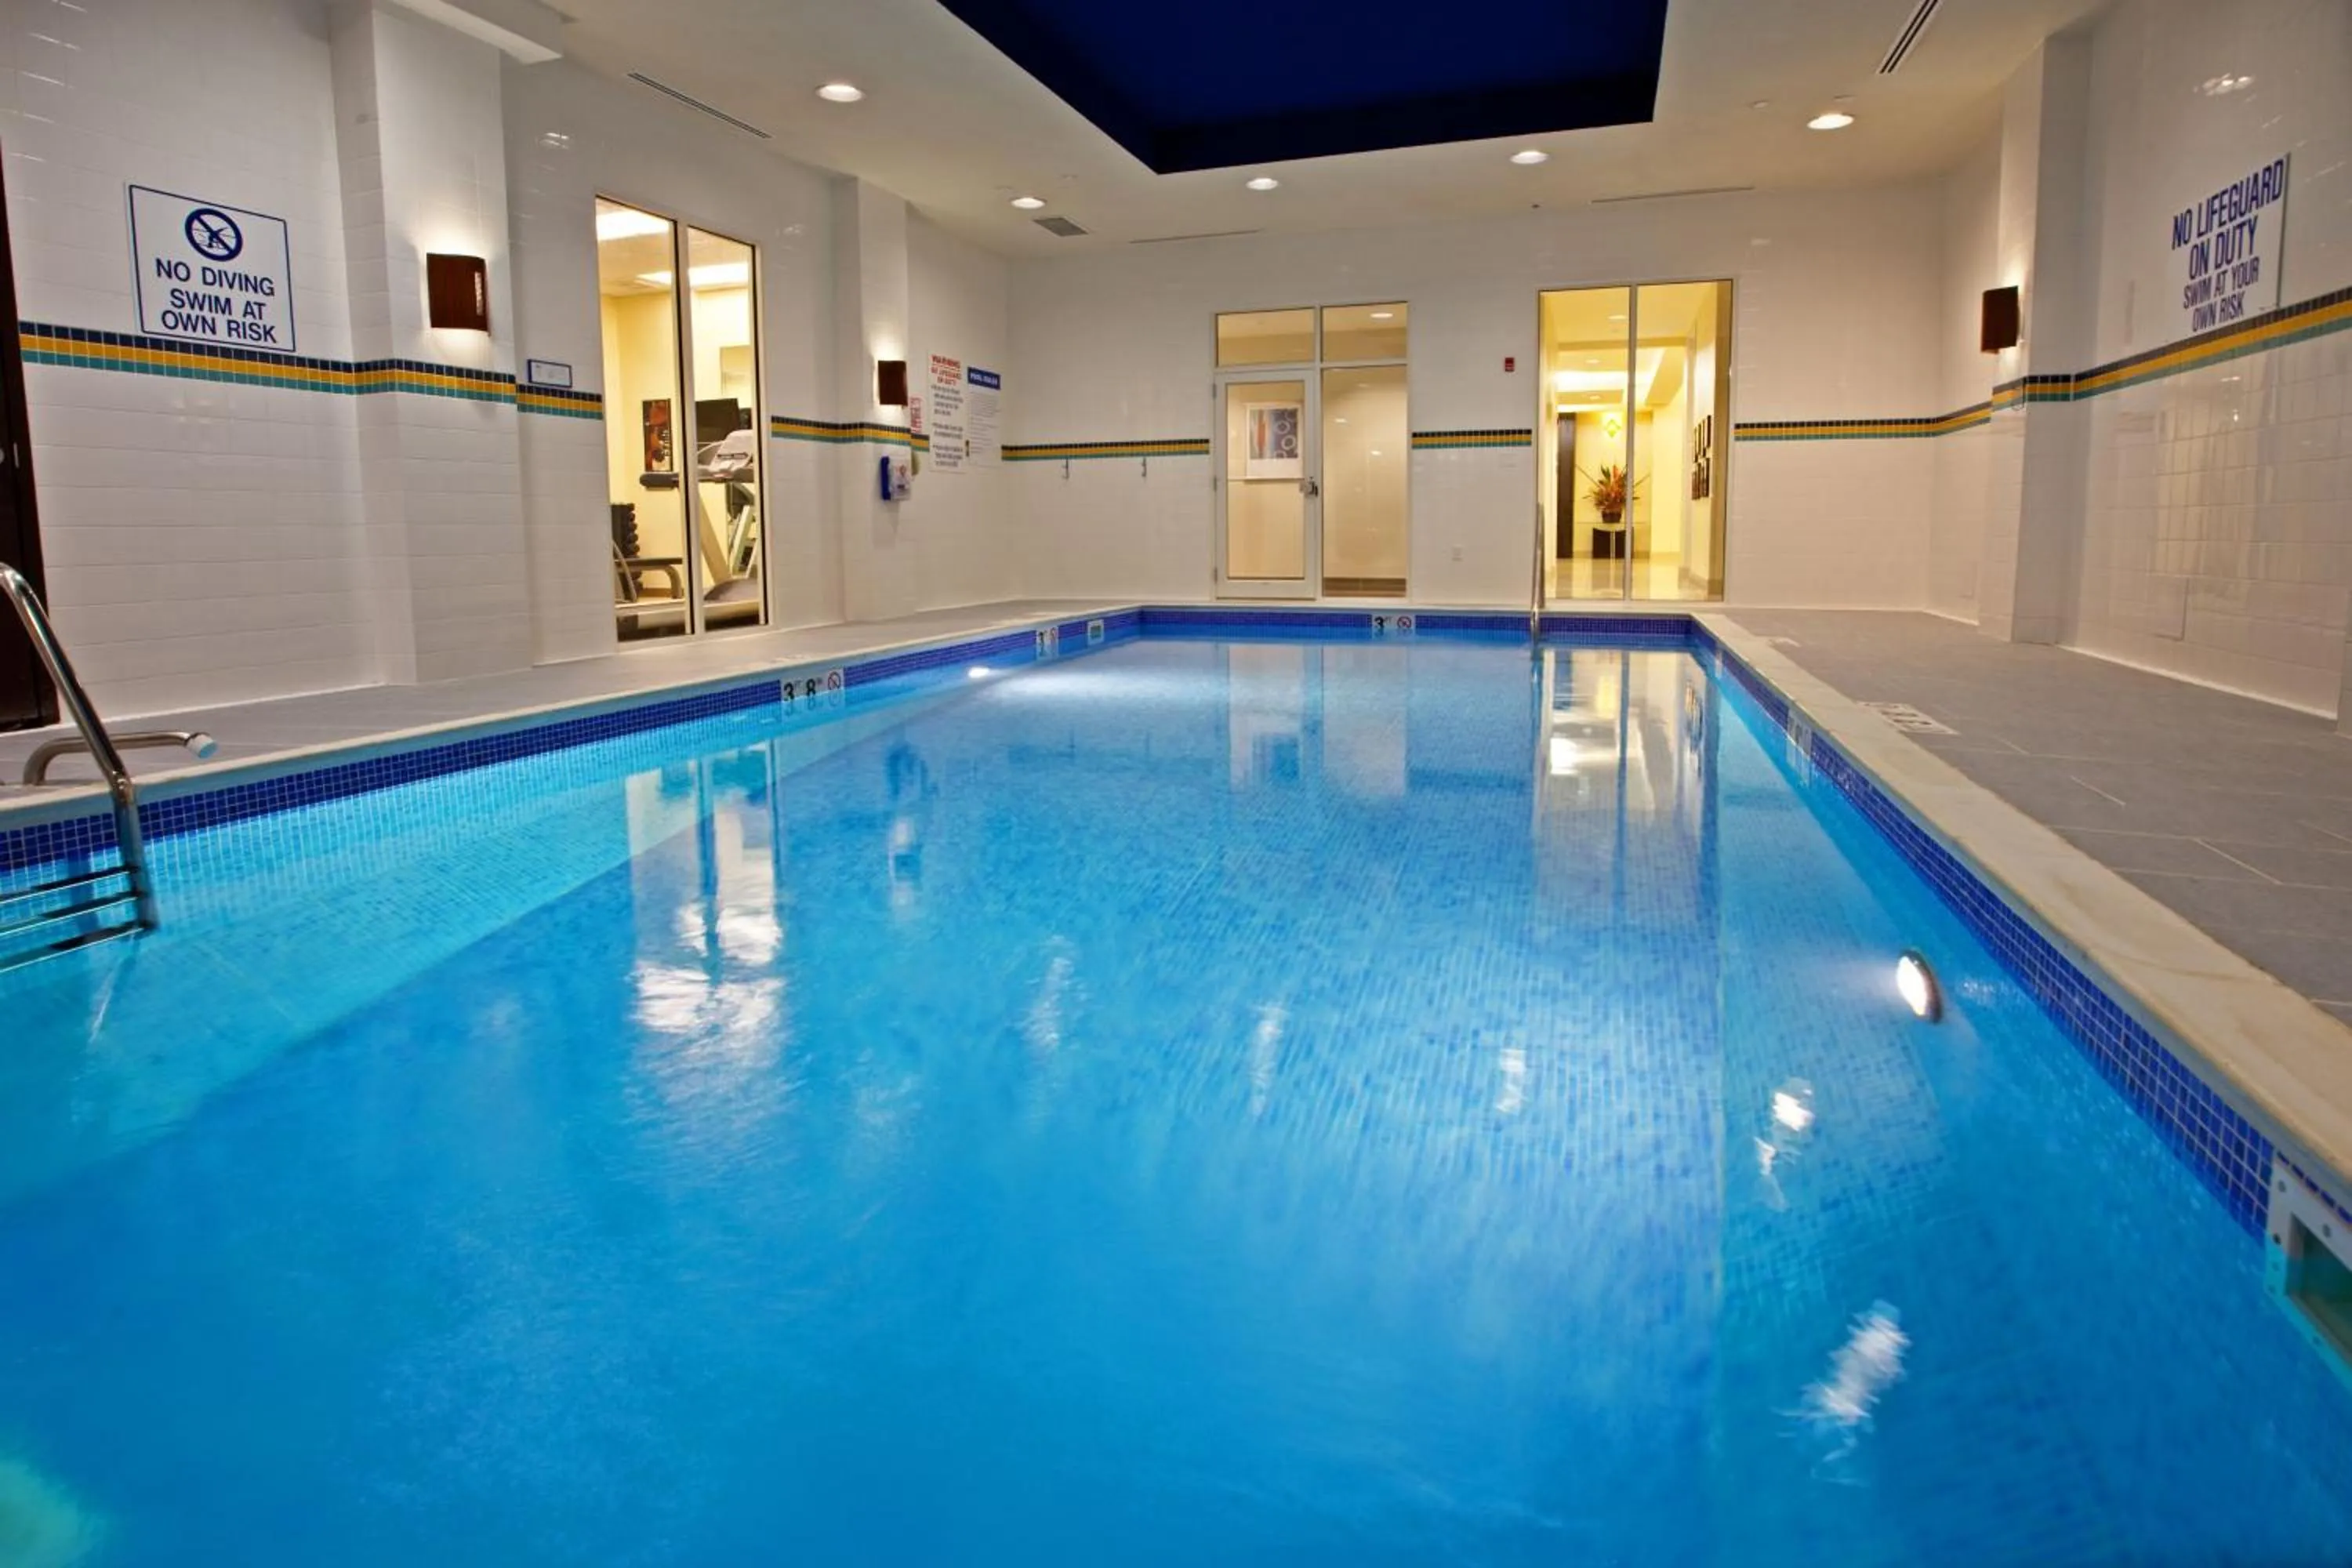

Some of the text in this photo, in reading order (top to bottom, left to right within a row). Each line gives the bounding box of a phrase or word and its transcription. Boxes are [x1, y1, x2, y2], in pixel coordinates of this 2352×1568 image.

[2172, 159, 2285, 249] NO LIFEGUARD
[2189, 216, 2258, 280] ON DUTY
[155, 257, 275, 297] NO DIVING
[2183, 256, 2260, 309] SWIM AT YOUR
[169, 288, 267, 321] SWIM AT
[2192, 291, 2245, 332] OWN RISK
[162, 310, 278, 343] OWN RISK
[784, 682, 795, 701] 3
